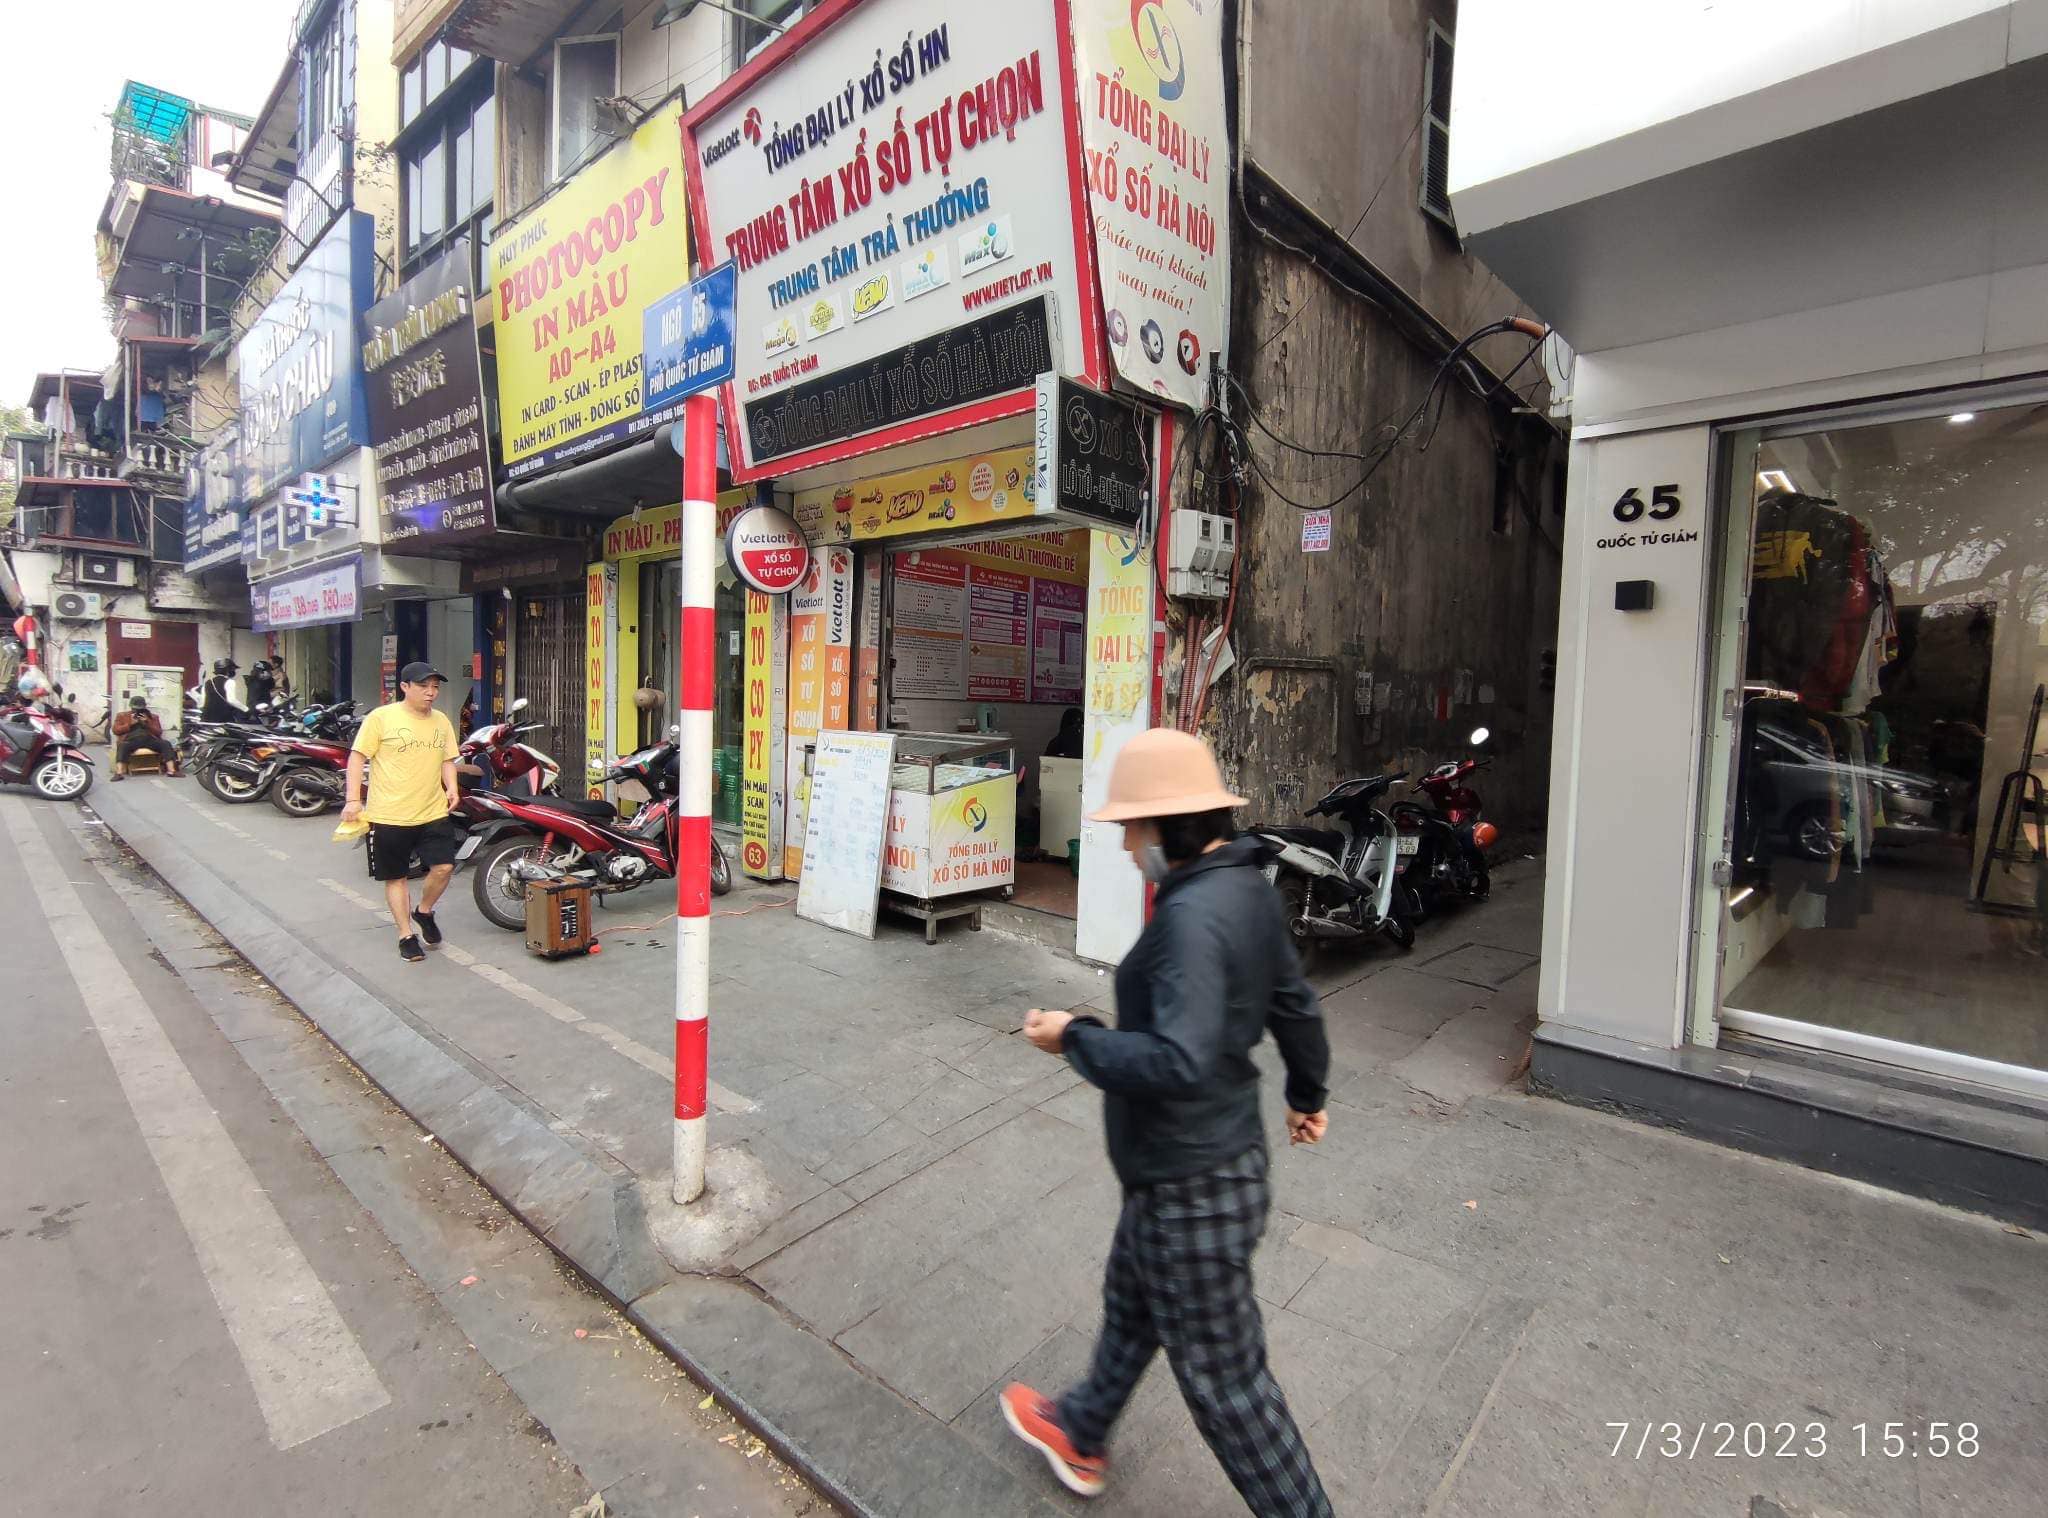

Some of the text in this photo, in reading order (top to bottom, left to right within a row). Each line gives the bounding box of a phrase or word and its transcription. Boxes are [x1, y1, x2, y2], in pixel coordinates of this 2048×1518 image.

[763, 23, 950, 174] TỔNG ĐẠI LÝ XỔ SỐ HN
[1096, 66, 1210, 184] TỔNG ĐẠI LÝ
[725, 49, 1044, 273] TRUNG TÂM XỔ SỐ TỰ CHỌN
[1087, 141, 1216, 261] XỔ SỐ HÀ NỘI
[499, 218, 547, 269] HUY PHÚC
[499, 166, 669, 321] PHOTOCOPY
[768, 262, 819, 310] TRUNG
[821, 245, 858, 284] TÂM
[862, 212, 900, 266] TRẢ
[903, 176, 990, 246] THƯỞNG
[964, 248, 990, 266] Max
[1095, 215, 1208, 291] Chúc quý khách
[1118, 269, 1148, 298] may
[1152, 285, 1184, 312] mắn
[533, 307, 558, 352] IN
[567, 264, 629, 334] MÀU
[661, 292, 707, 347] NGÕ 65
[590, 325, 617, 363] A4
[766, 335, 785, 351] Mega
[282, 330, 334, 421] CHÂU
[650, 343, 723, 396] PHỐ QUỐC TỬ GIÁM
[775, 384, 822, 448] TỔNG
[887, 342, 921, 417] XỔ
[921, 330, 954, 404] SỐ
[954, 326, 994, 395] HÀ
[992, 311, 1045, 388] NỘI
[800, 353, 820, 372] GIÁM
[522, 406, 532, 424] IN
[533, 394, 556, 418] CARD
[565, 378, 590, 405] SCAN
[599, 366, 610, 389] ÉP
[513, 431, 536, 454] ĐÁNH
[538, 420, 557, 444] MÁY
[559, 407, 582, 435] TÍNH
[590, 397, 621, 423] ĐÓNG
[1613, 484, 1681, 522] 65
[608, 530, 621, 555] IN
[624, 521, 653, 551] MÀU
[740, 532, 786, 544] Vietlott
[1597, 528, 1697, 549] QUỐC TỬ GIÁM
[758, 566, 799, 580] TỰ CHỌN
[764, 550, 791, 564] XỔ SỐ
[588, 573, 603, 607] PHO
[795, 597, 823, 608] Vietlott
[1099, 575, 1144, 615] TỔNG
[831, 578, 844, 644] Vietlott
[591, 616, 601, 648] TO
[751, 626, 765, 667] TO
[802, 617, 816, 642] XỔ
[591, 656, 601, 689] CO
[801, 647, 816, 671] SỐ
[831, 652, 844, 673] XỔ
[750, 679, 765, 718] CO
[831, 678, 843, 697] SỐ
[591, 698, 601, 731] PY
[749, 730, 764, 771] PY
[744, 778, 751, 791] IN
[747, 795, 764, 809] SCAN
[893, 815, 906, 832] LÝ
[748, 847, 762, 865] 63
[887, 845, 918, 874] NỘI
[949, 839, 999, 859] TỔNG ĐẠI LÝ
[933, 856, 1011, 884] XỔ SỐ HÀ NỘI
